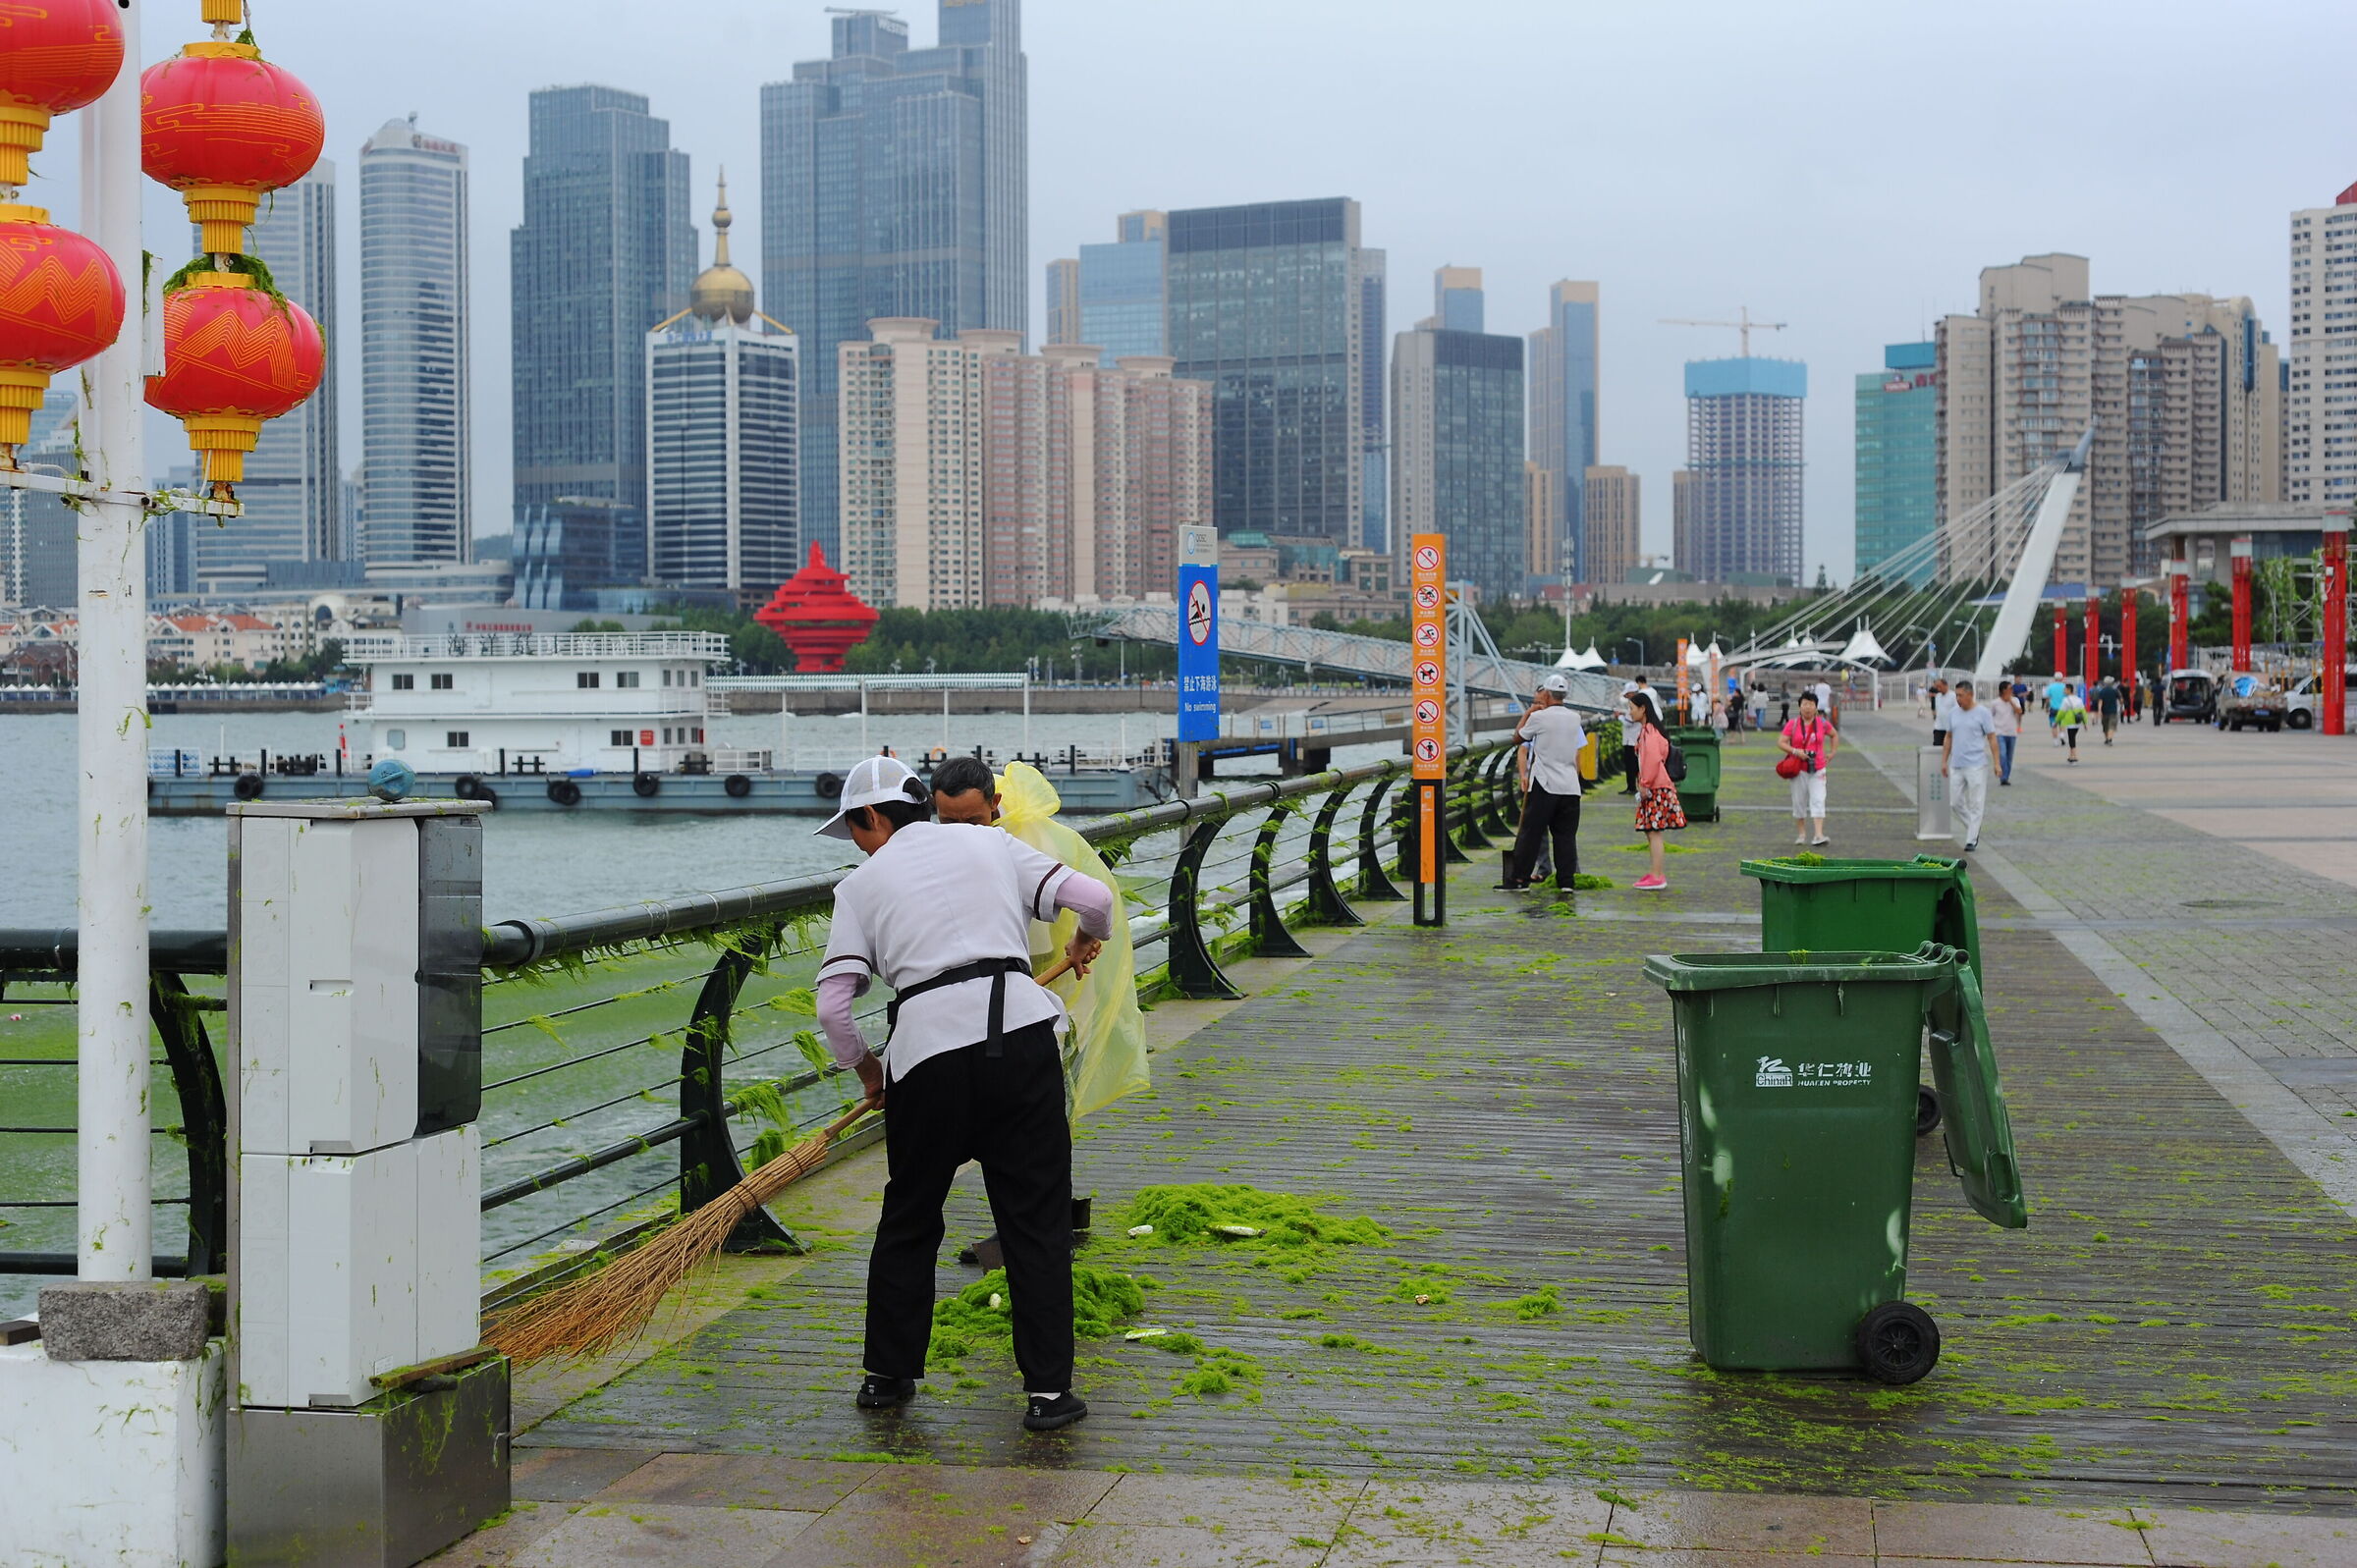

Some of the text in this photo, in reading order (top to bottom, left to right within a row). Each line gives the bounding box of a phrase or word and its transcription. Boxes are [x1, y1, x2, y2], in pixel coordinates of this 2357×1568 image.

[1184, 702, 1192, 712] No
[1797, 1060, 1872, 1078] 华仁物业
